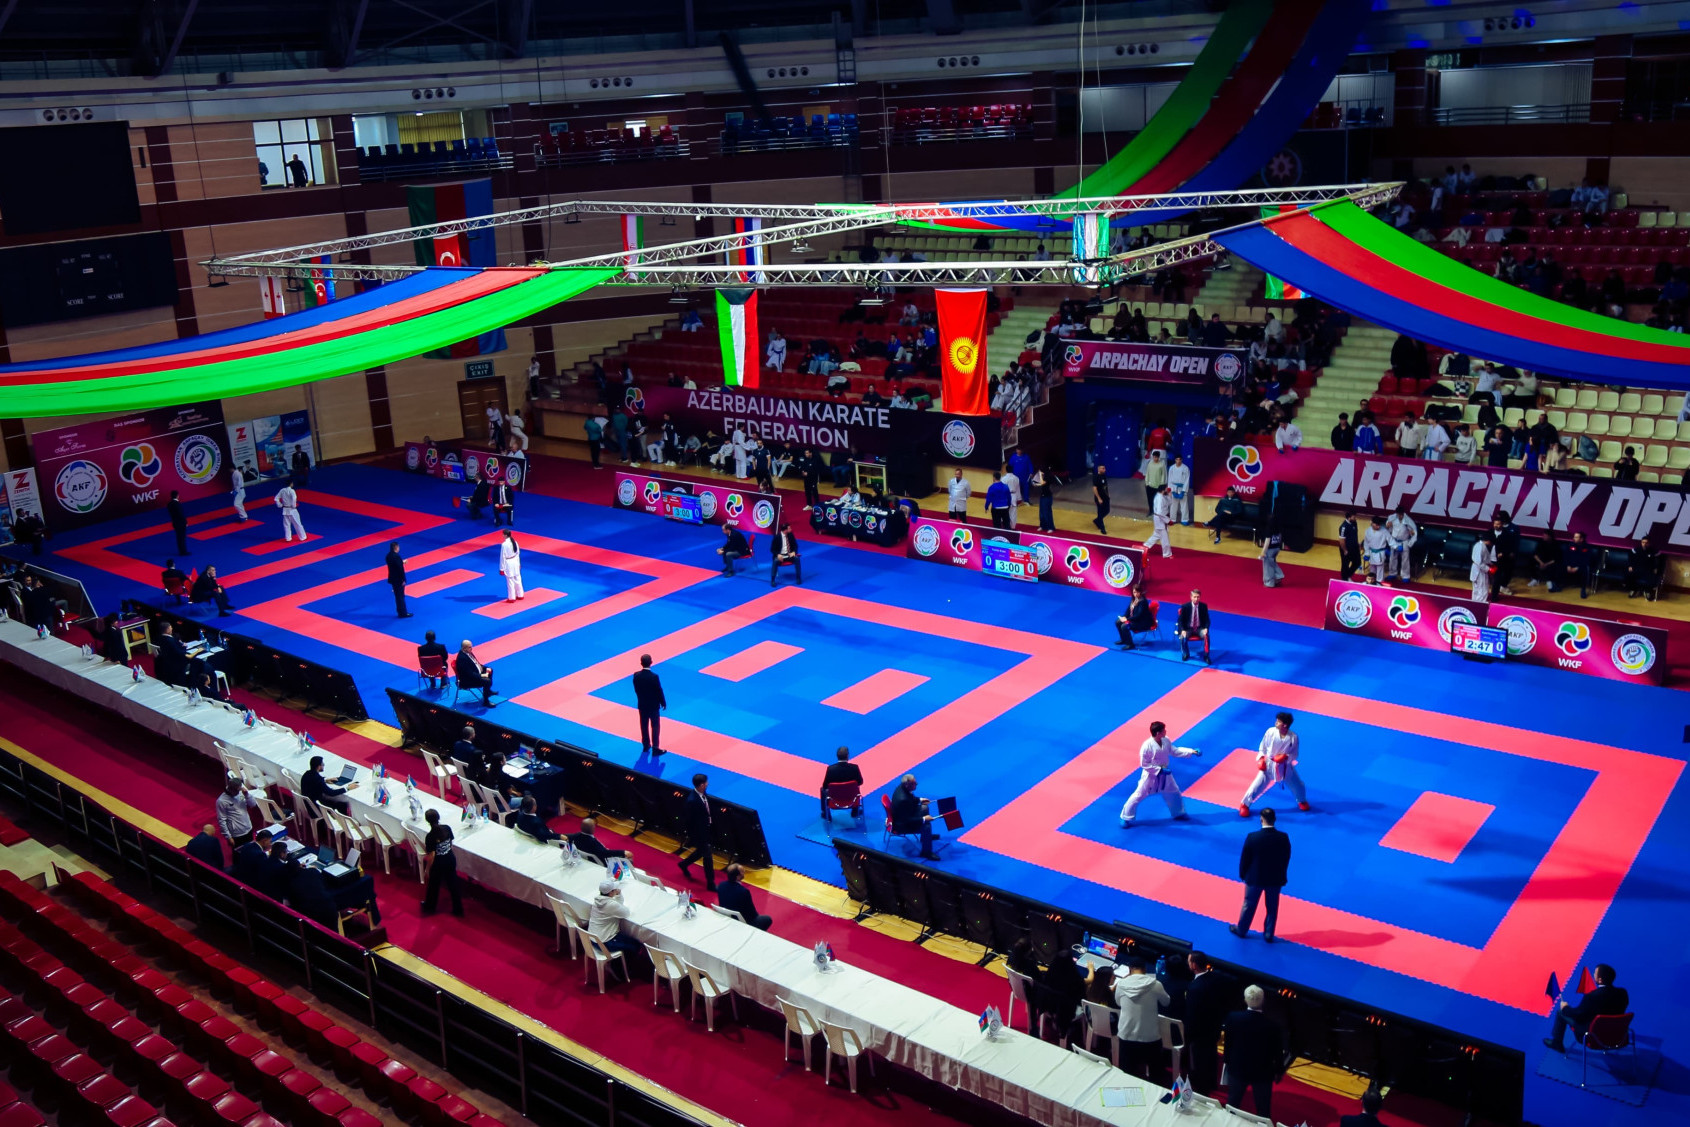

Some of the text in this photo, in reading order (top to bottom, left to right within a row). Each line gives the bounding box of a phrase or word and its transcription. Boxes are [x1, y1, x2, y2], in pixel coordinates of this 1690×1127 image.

[1089, 351, 1209, 375] ARPACHAY OPEN
[687, 391, 891, 429] AZERBAIJAN KARATE
[71, 481, 91, 492] AKF
[1232, 484, 1257, 495] WKF
[131, 489, 160, 504] WKF
[1319, 457, 1597, 532] ARPACHAY
[675, 508, 690, 518] 3:00
[952, 556, 968, 565] WKF
[985, 555, 992, 566] 0
[999, 561, 1020, 573] 3:00
[1027, 562, 1034, 574] 0
[1067, 575, 1085, 584] WKF
[1390, 629, 1413, 640] WKF
[1454, 634, 1463, 645] 0
[1467, 640, 1491, 652] 2:47
[1496, 641, 1504, 652] 0
[1558, 657, 1582, 669] WKF
